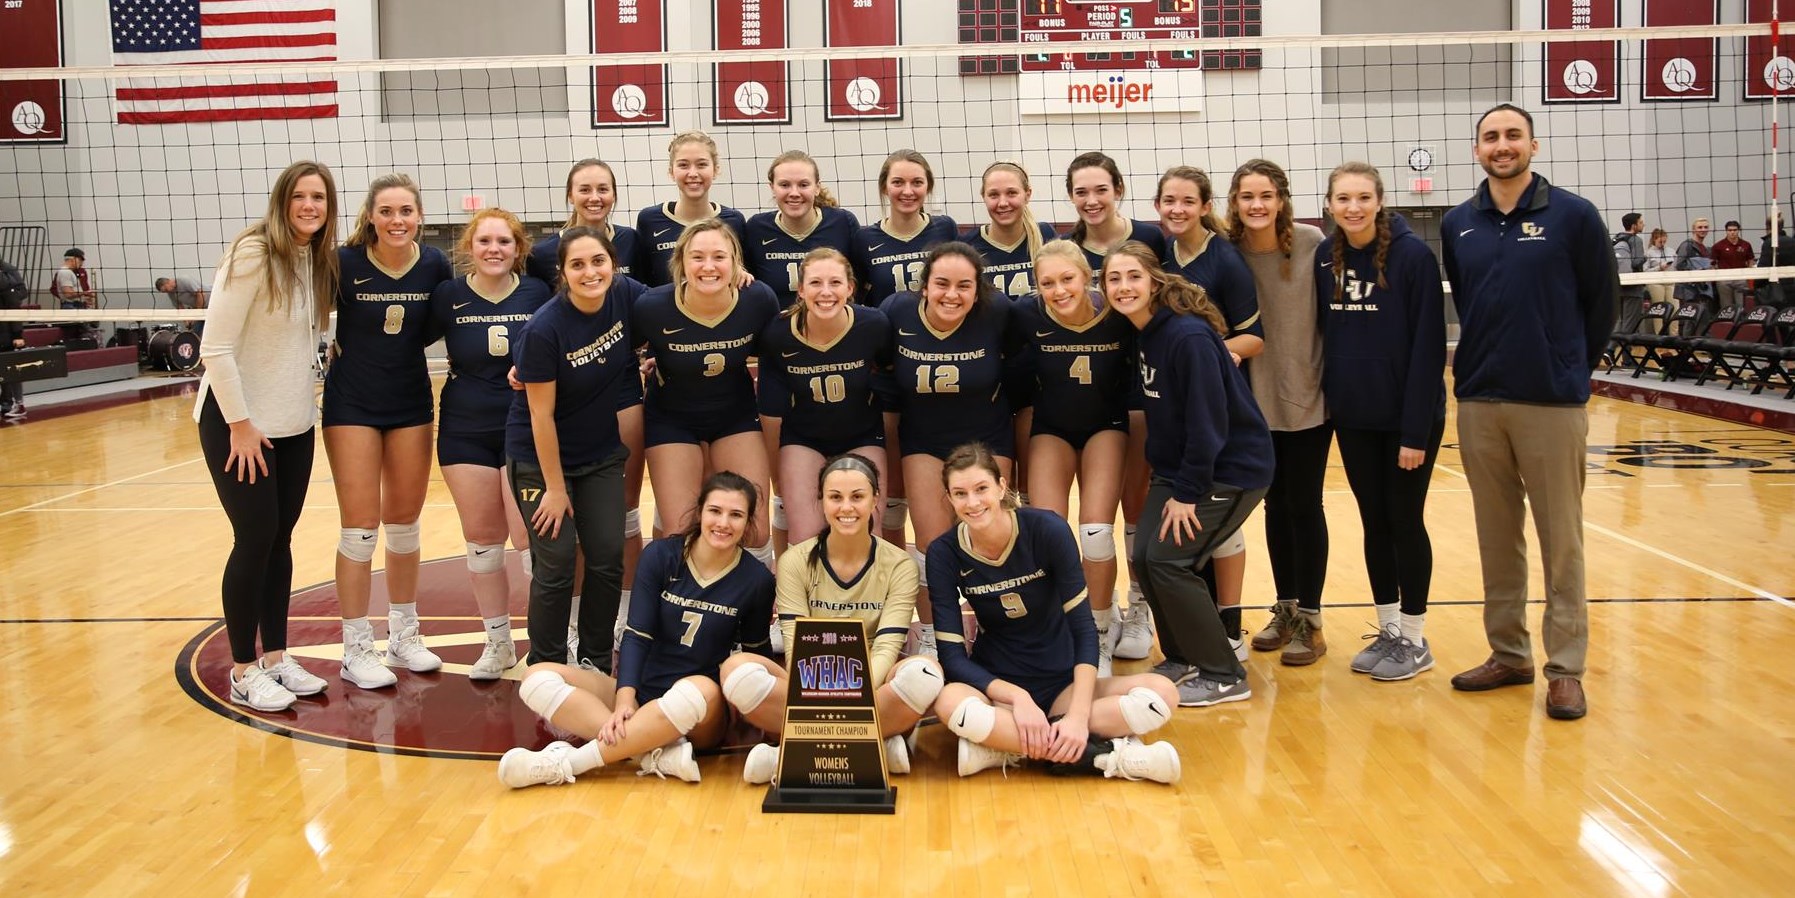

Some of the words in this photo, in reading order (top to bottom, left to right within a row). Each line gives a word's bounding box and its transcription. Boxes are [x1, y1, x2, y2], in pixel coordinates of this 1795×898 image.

[4, 0, 22, 8] 2017
[1093, 4, 1110, 12] POSS
[1087, 12, 1116, 21] PERIOD
[1120, 8, 1132, 27] 5
[1572, 7, 1591, 16] 2009
[1039, 19, 1065, 27] BONUS
[1154, 17, 1180, 25] BONUS
[1572, 15, 1591, 24] 2010
[1024, 33, 1050, 42] FOULS
[1081, 32, 1111, 41] PLAYER
[1121, 31, 1146, 40] FOULS
[1170, 30, 1196, 39] FOULS
[1067, 76, 1152, 108] meijer
[765, 252, 808, 260] CORNER
[871, 251, 932, 265] CORNERST
[982, 261, 1034, 274] ORNERSTO
[892, 261, 925, 293] 13
[993, 271, 1031, 297] 14
[383, 304, 405, 335] 8
[488, 325, 509, 357] 6
[668, 333, 753, 353] CORNERSTONE
[1041, 342, 1120, 352] CORNERSTONE
[898, 344, 986, 362] CORNERSTONE
[703, 353, 726, 377] 3
[787, 359, 865, 375] CORNERSTONE
[1069, 355, 1092, 385] 4
[915, 364, 960, 394] 12
[809, 374, 846, 404] 10
[520, 488, 541, 502] 17
[810, 600, 884, 611] ORNERSTONE
[1000, 592, 1028, 619] 9
[680, 610, 704, 648] 7
[797, 654, 863, 690] WHAC
[794, 725, 834, 736] TOURNAMENT
[836, 726, 868, 736] CHAMPION
[814, 757, 849, 770] WOMENS
[808, 772, 855, 786] VOLLEYBALL
